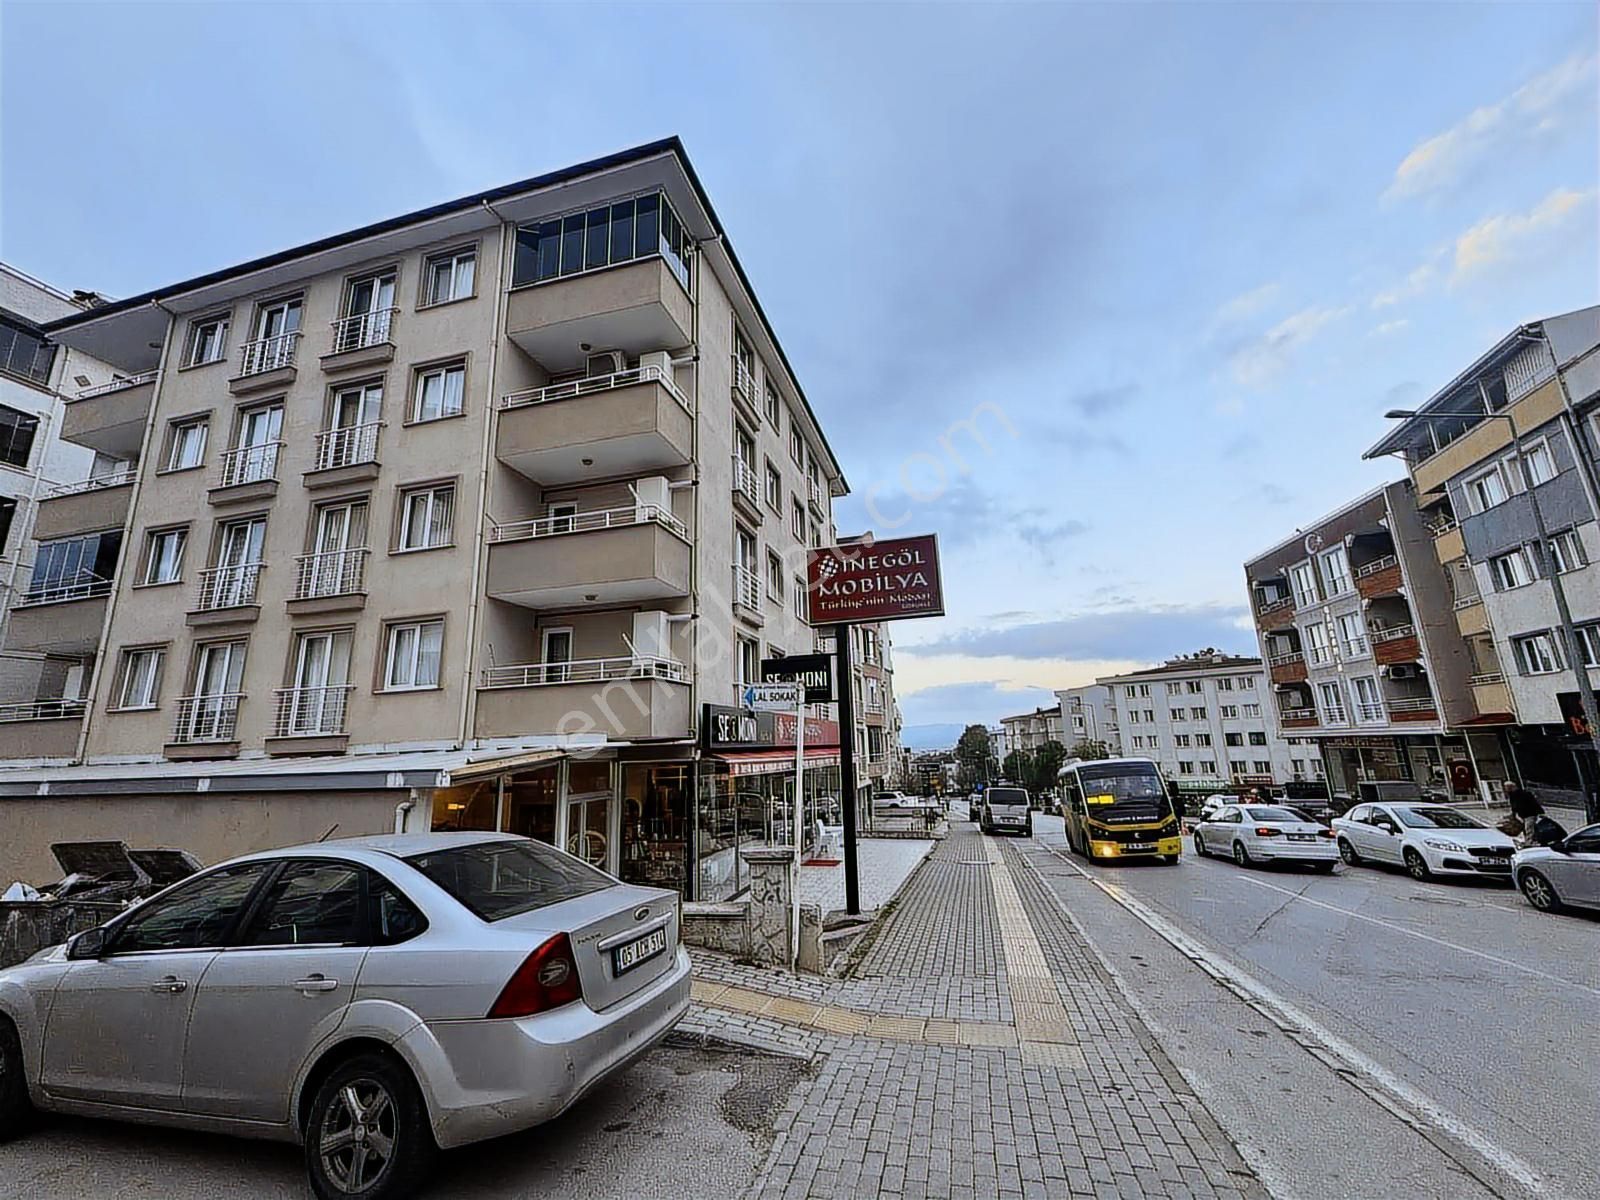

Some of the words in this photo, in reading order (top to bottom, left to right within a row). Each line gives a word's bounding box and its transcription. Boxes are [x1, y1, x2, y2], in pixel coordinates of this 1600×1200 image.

[841, 549, 926, 572] İNEGÖL
[818, 573, 928, 597] MOBİLYA
[769, 692, 797, 702] SOKAK
